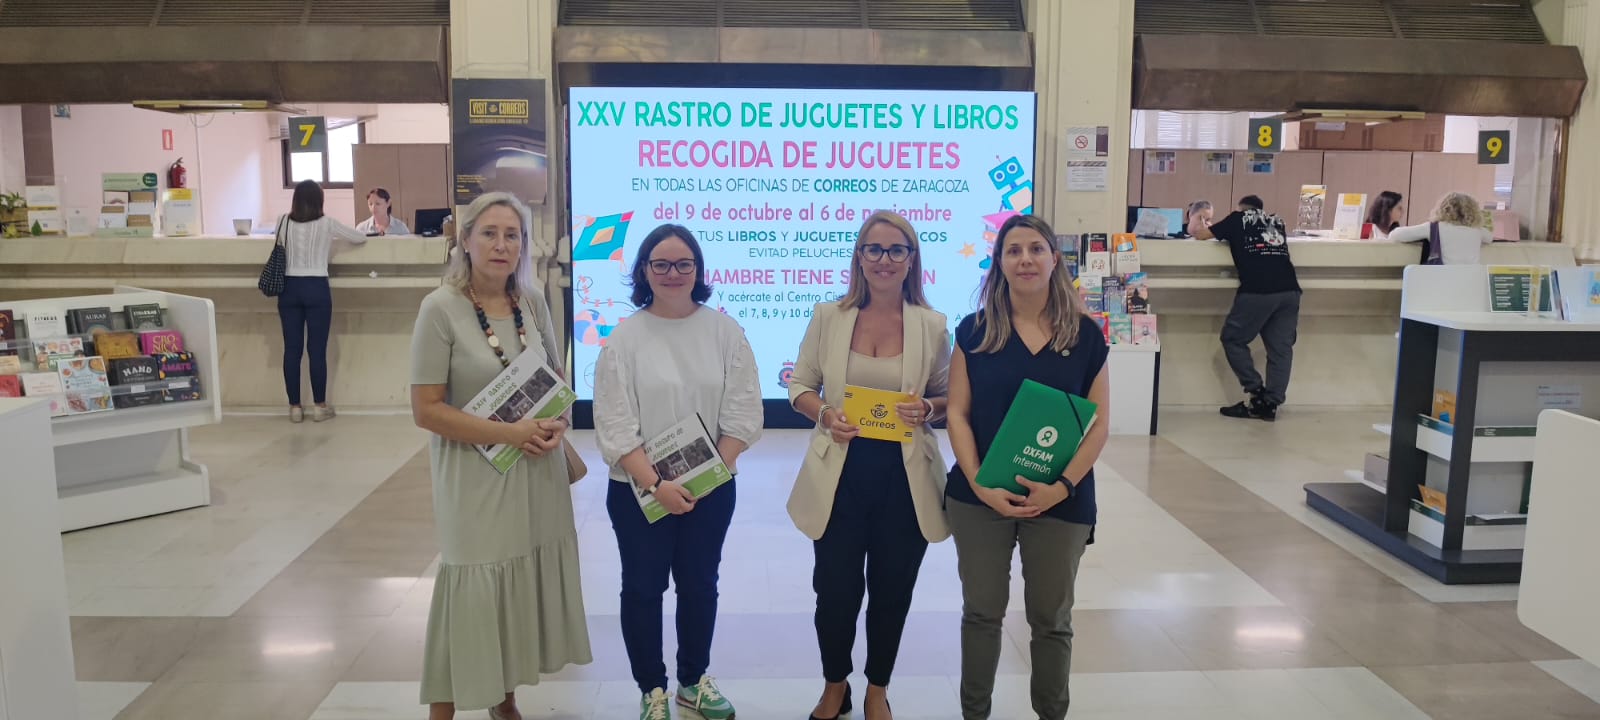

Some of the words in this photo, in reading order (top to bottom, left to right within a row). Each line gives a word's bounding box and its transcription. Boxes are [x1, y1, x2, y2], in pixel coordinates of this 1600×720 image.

[472, 102, 487, 115] VISIT
[498, 102, 526, 115] CORREOS
[577, 101, 626, 127] XXV
[635, 101, 732, 128] RASTRO
[741, 102, 773, 128] DE
[780, 103, 903, 129] JUGUETES
[911, 104, 926, 129] Y
[934, 104, 1019, 130] LIBROS
[299, 124, 316, 147] 7
[1257, 125, 1273, 148] 8
[638, 140, 774, 168] RECOGIDA
[783, 141, 817, 169] DE
[825, 141, 961, 169] JUGUETES
[1486, 137, 1503, 158] 9
[631, 178, 650, 192] EN
[653, 178, 694, 192] TODAS
[699, 178, 722, 192] LAS
[726, 178, 788, 193] OFICINAS
[792, 179, 809, 192] DE
[813, 178, 877, 193] CORREOS
[882, 179, 899, 192] DE
[903, 179, 970, 193] ZARAGOZA
[653, 201, 679, 221] del
[685, 204, 695, 220] 9
[701, 201, 722, 221] de
[728, 201, 793, 221] octubre
[799, 202, 814, 221] al
[821, 204, 830, 221] 6
[835, 202, 856, 221] de
[862, 202, 952, 222] nembre
[697, 230, 724, 242] TUS
[728, 230, 777, 242] LIBROS
[781, 231, 789, 242] Y
[749, 248, 789, 258] EVITAD
[792, 248, 853, 258] PELUCHES
[781, 269, 834, 285] TIENE
[717, 291, 725, 302] Y
[728, 291, 772, 302] acércate
[775, 291, 784, 302] al
[787, 291, 822, 302] Centro
[739, 307, 747, 318] el
[751, 308, 760, 320] 7,
[762, 308, 771, 320] 8,
[773, 308, 779, 318] 9
[781, 310, 788, 320] y
[790, 308, 801, 318] 10
[122, 365, 153, 377] HAND
[859, 417, 896, 430] Correos
[1022, 445, 1054, 463] OXFAM
[1012, 454, 1052, 475] Intermón
